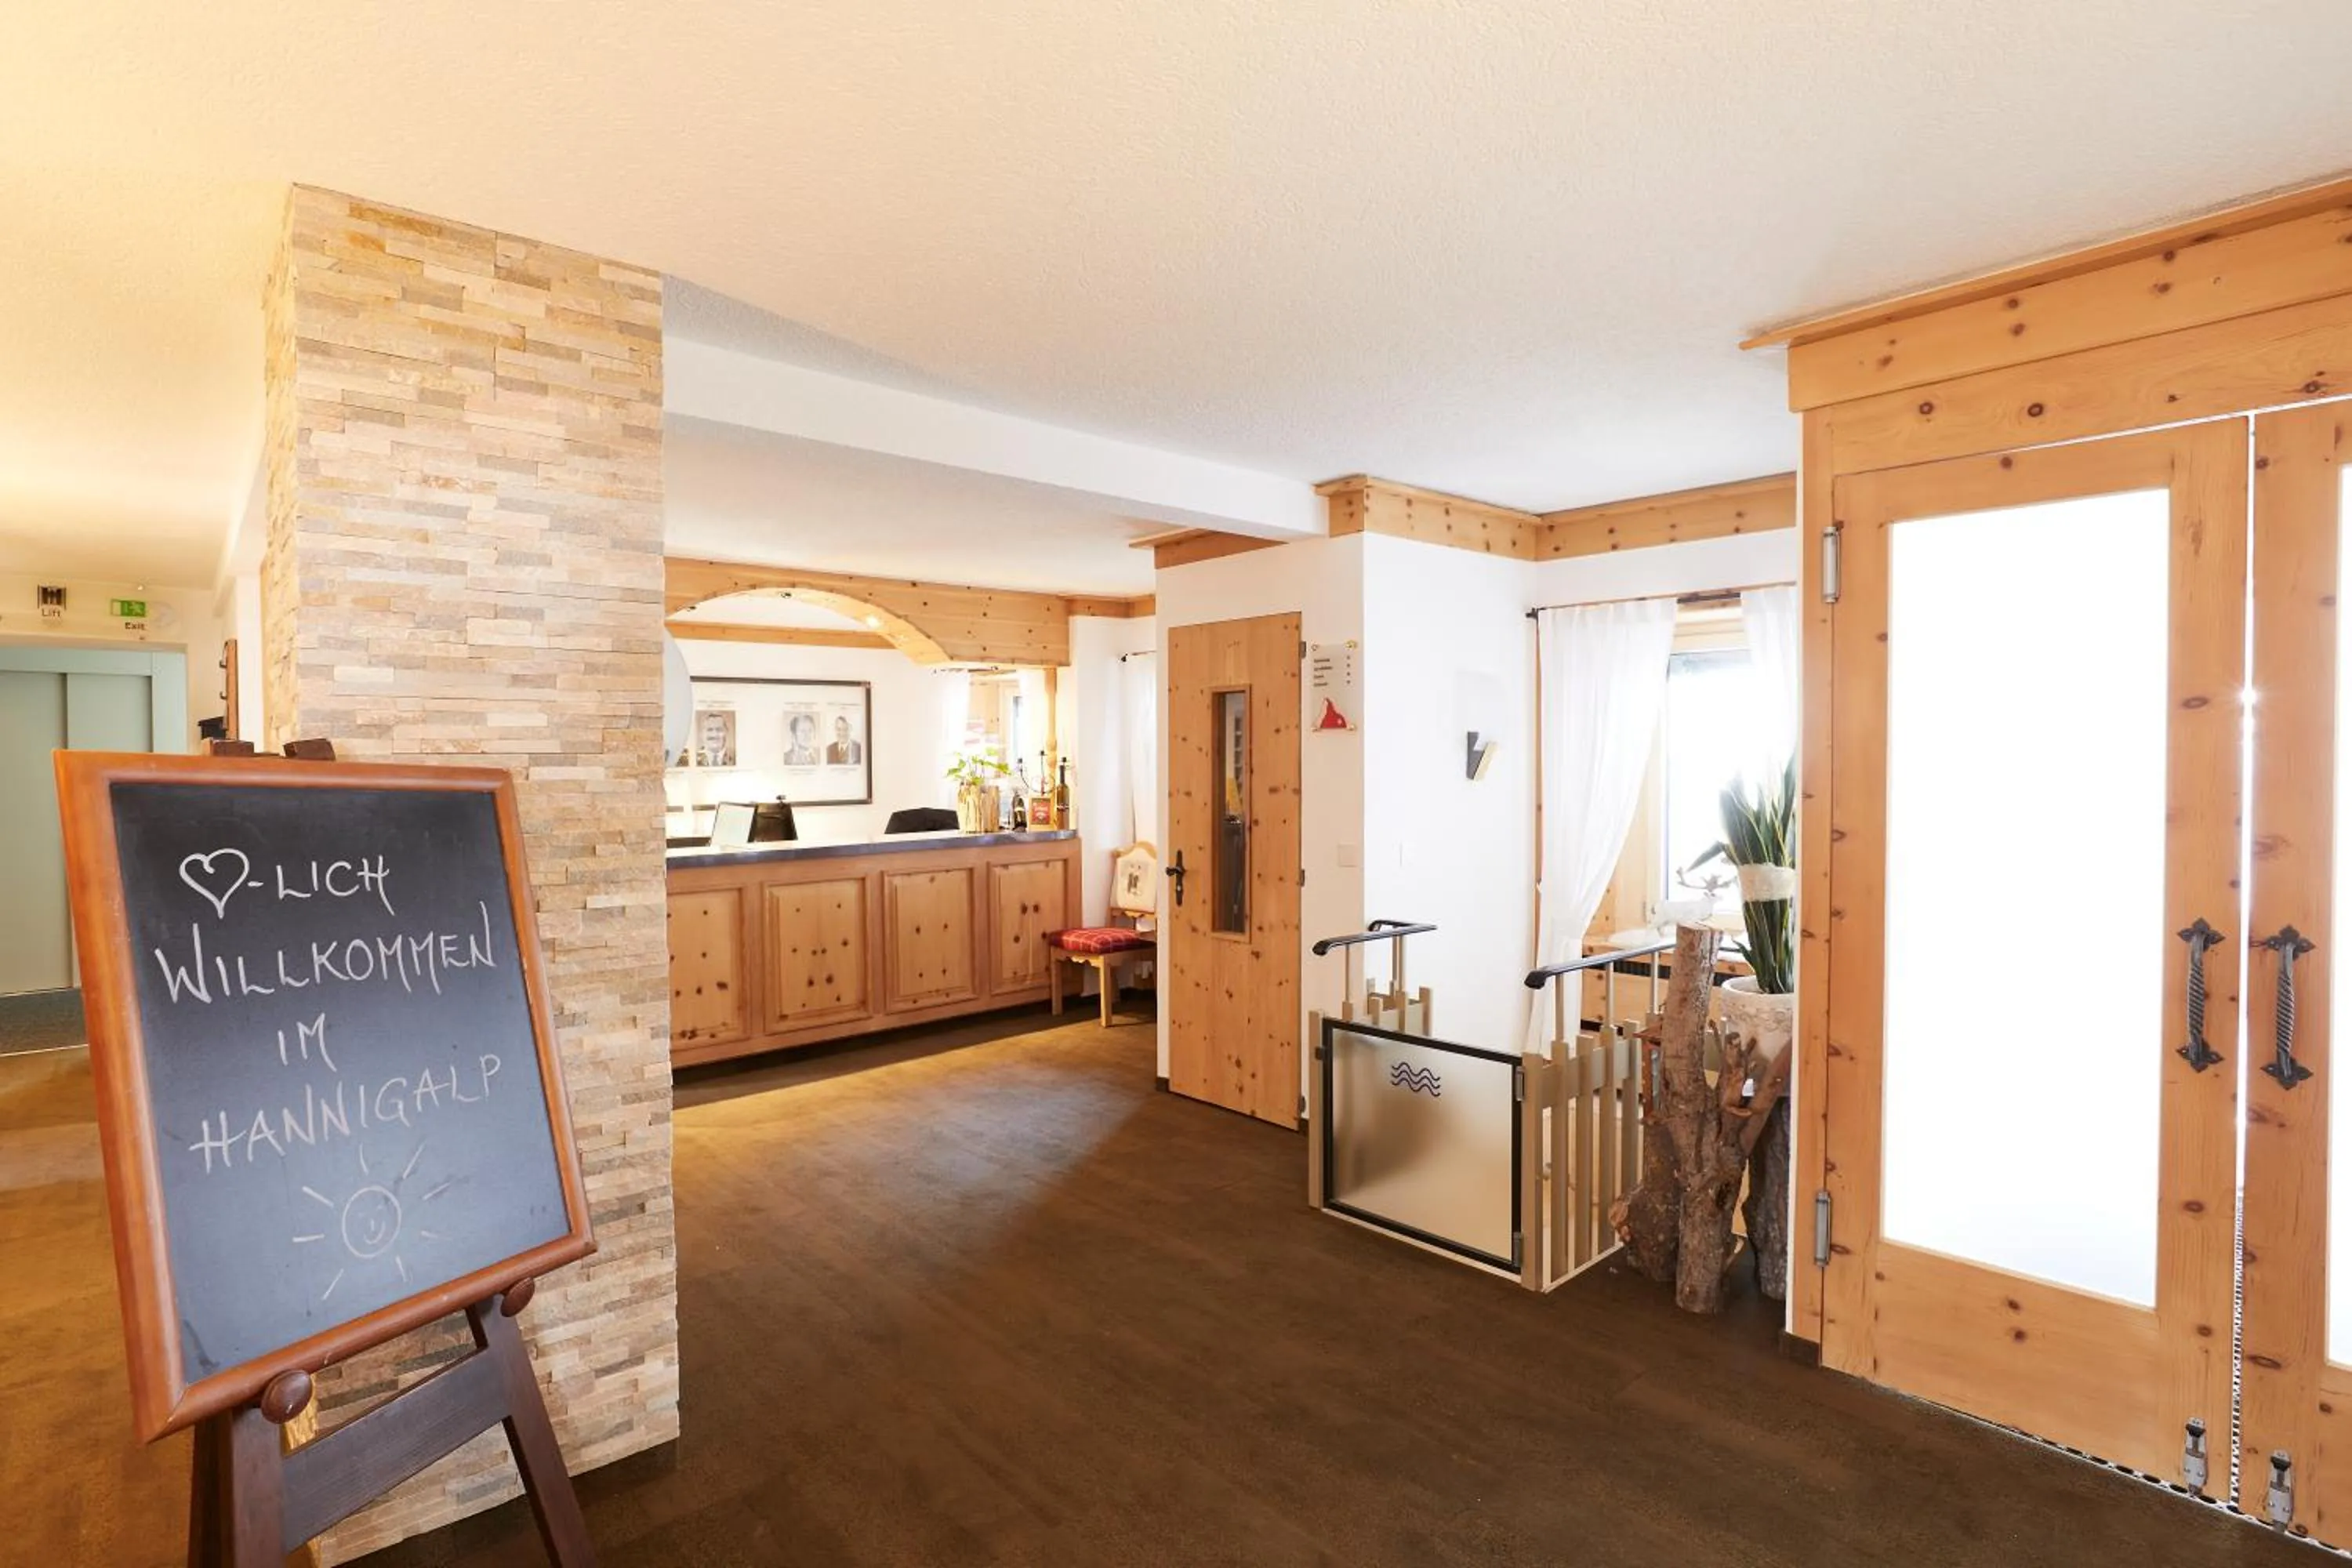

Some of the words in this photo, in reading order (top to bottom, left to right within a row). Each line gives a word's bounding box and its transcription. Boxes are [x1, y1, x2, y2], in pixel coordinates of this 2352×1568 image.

[42, 608, 61, 617] Lift
[125, 622, 146, 630] Exit
[154, 900, 497, 1004] WILLKOMMEN
[278, 1012, 337, 1073] IM
[188, 1053, 501, 1174] HANNIGALP
